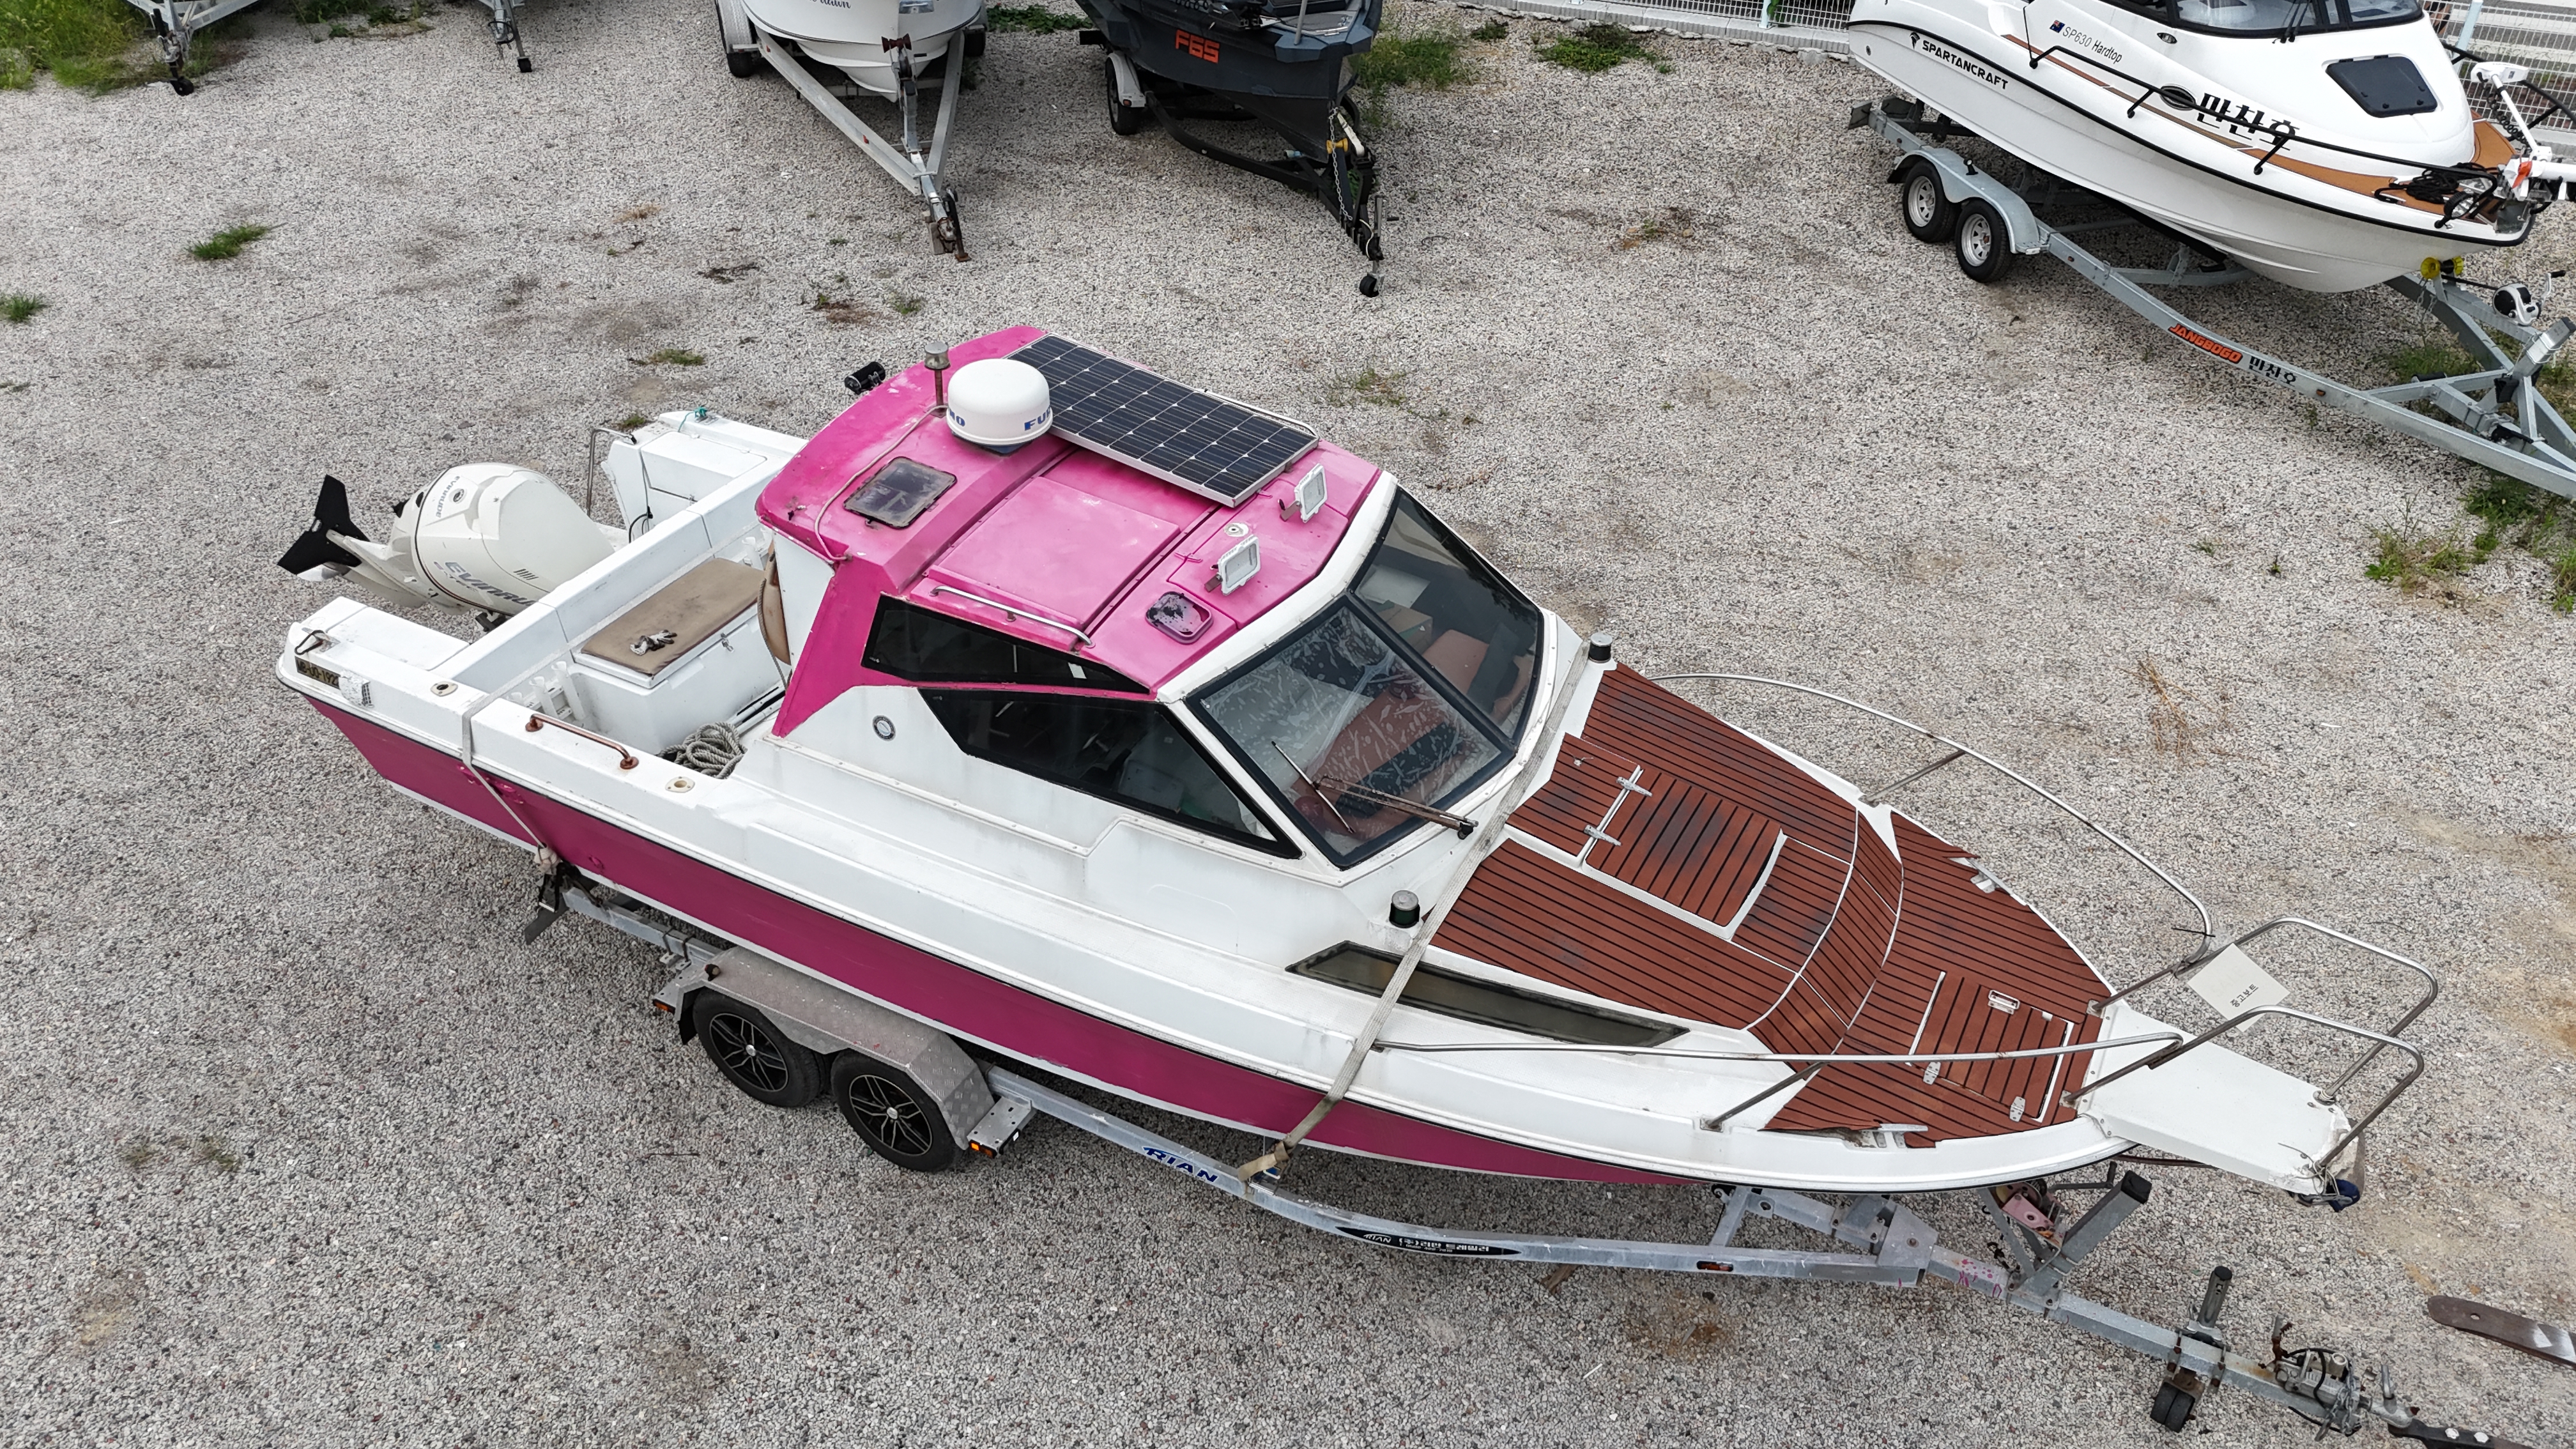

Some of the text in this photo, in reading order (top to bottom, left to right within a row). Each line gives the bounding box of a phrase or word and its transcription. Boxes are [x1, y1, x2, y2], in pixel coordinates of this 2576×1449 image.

[1922, 40, 2008, 89] SPARTANCRAFT
[2063, 27, 2122, 65] SP630 Hardtop
[2168, 323, 2243, 364] JANGBOGO
[2230, 984, 2259, 1008] 중고보트
[1142, 1147, 1218, 1183] RIAN
[1363, 1234, 1392, 1243] RIAN
